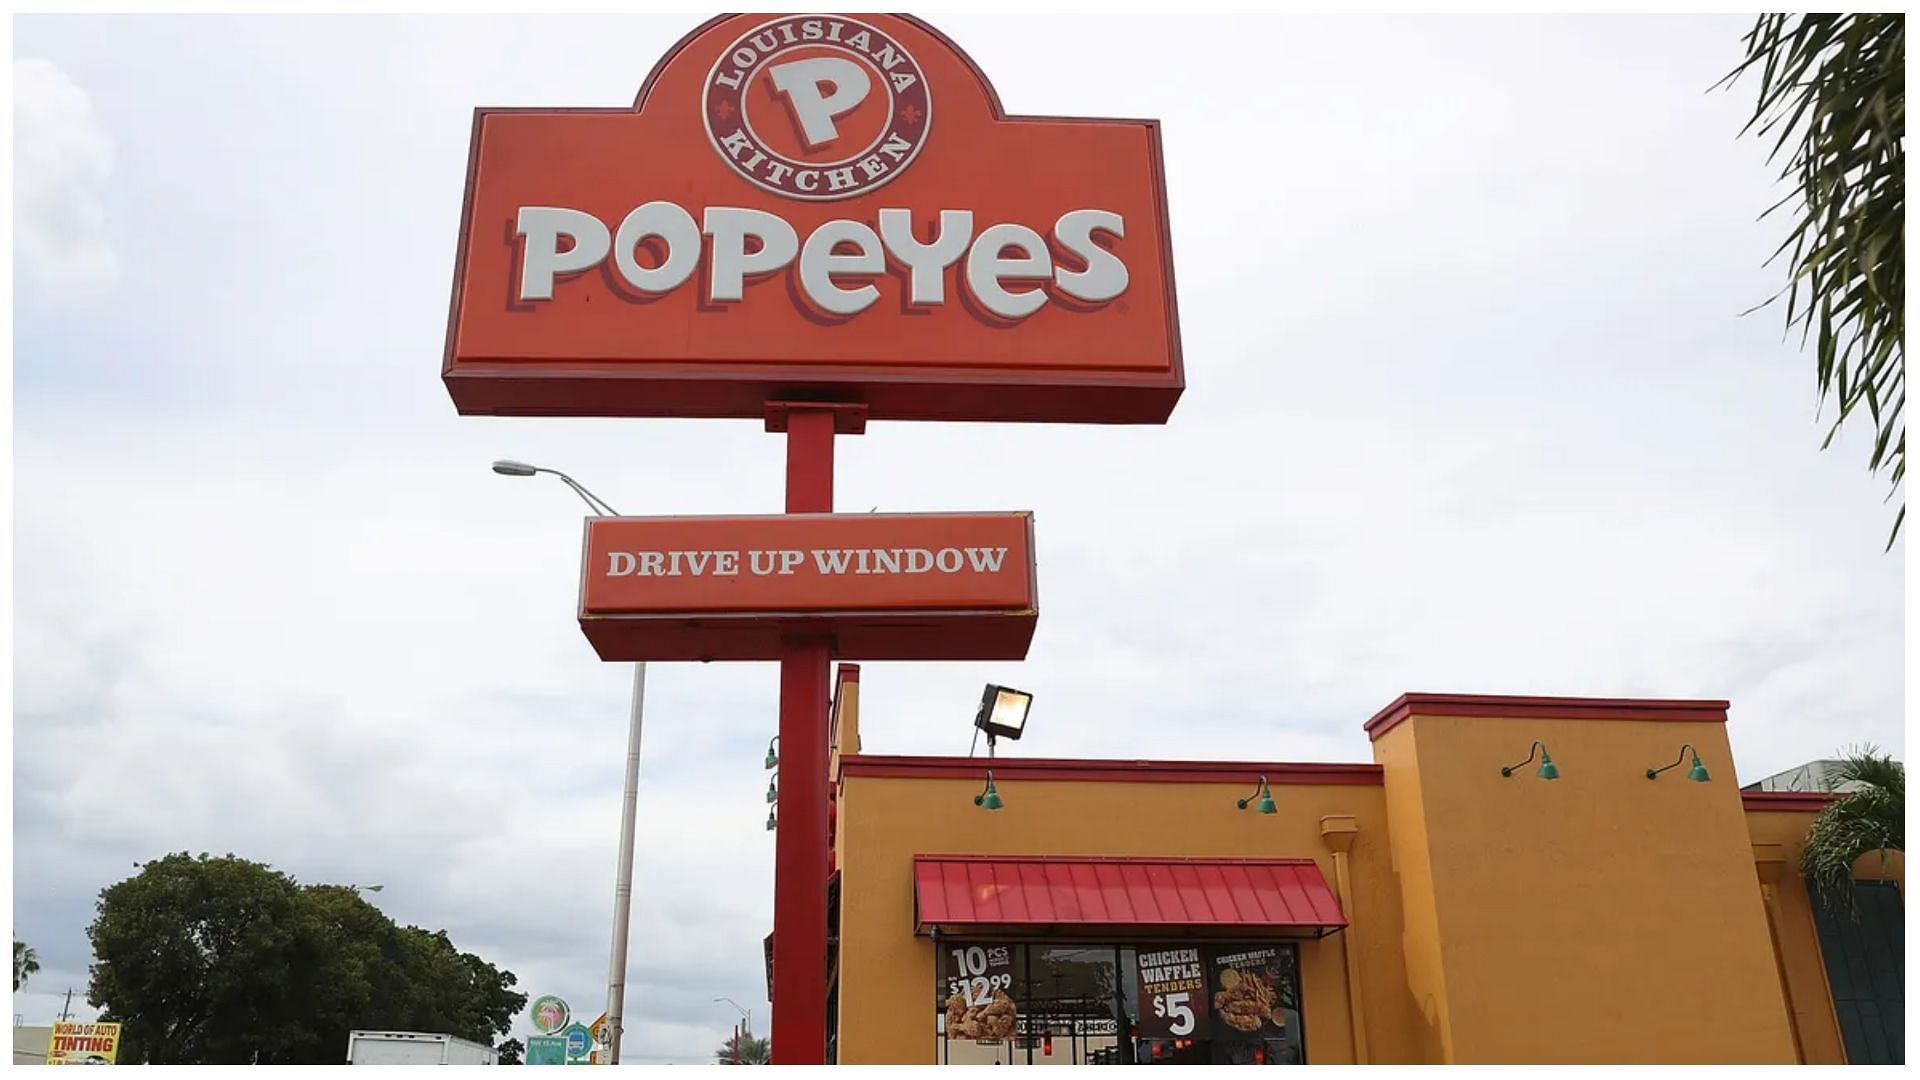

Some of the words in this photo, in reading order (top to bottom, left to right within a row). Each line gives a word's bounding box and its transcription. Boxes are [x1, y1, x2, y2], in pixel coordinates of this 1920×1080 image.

[716, 20, 917, 94] LOUISIANA
[768, 56, 872, 145] P
[720, 128, 912, 192] KITCHEN
[607, 550, 740, 577] DRIVE
[748, 550, 805, 576] UP
[811, 547, 1008, 575] WINDOW
[952, 946, 987, 977] 10
[1138, 948, 1199, 968] CHICKEN
[1215, 954, 1248, 965] CHICKEN
[1247, 948, 1276, 960] WAFFLE
[1140, 963, 1201, 983] WAFFLE
[1144, 979, 1203, 994] TENDERS
[1153, 991, 1195, 1036] $5
[55, 1023, 82, 1035] WORLD
[84, 1024, 95, 1036] OF
[95, 1025, 117, 1036] AUTO
[53, 1036, 114, 1052] TINTING
